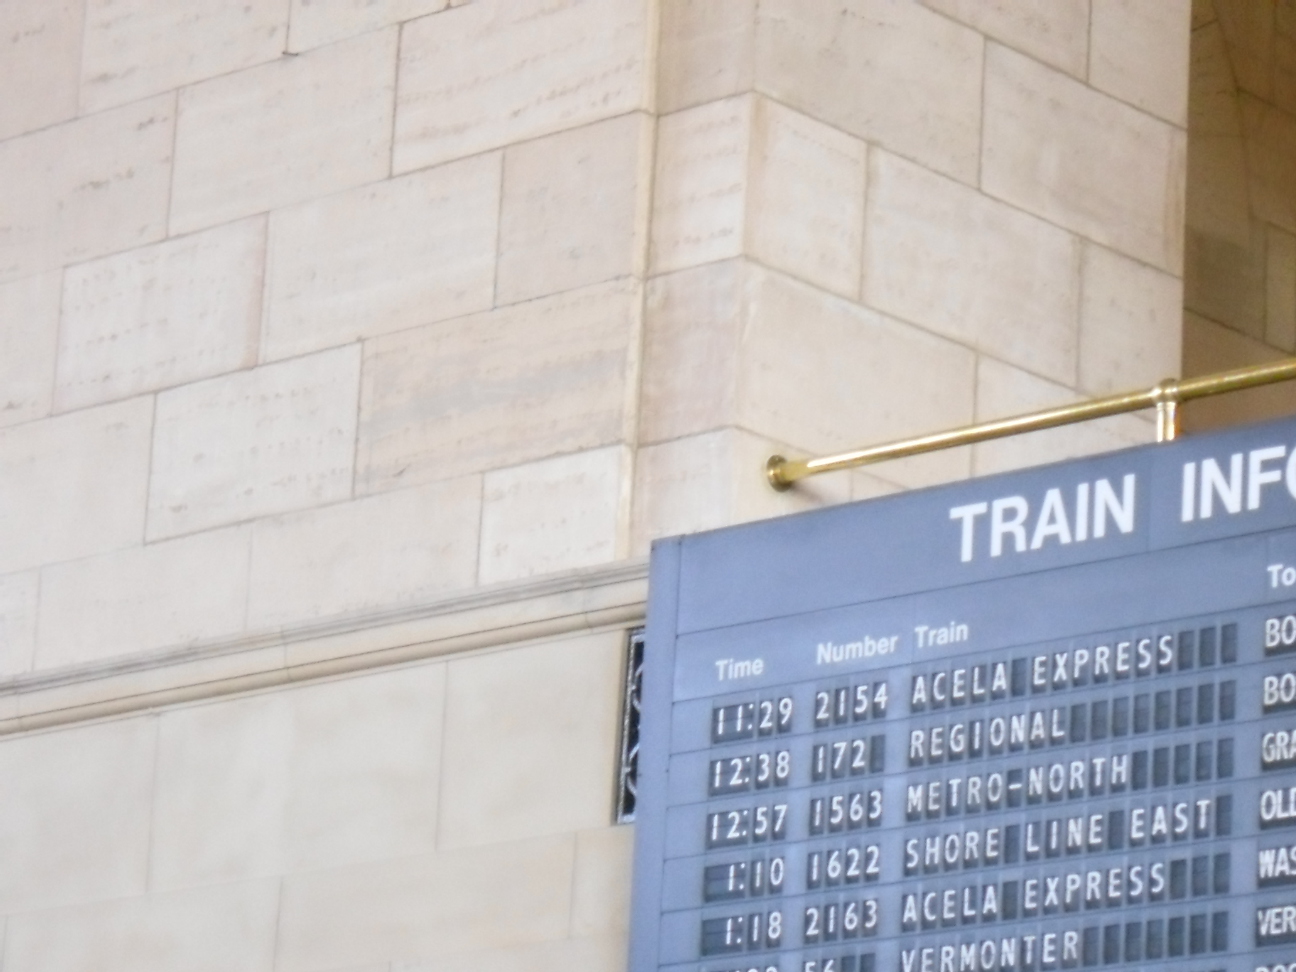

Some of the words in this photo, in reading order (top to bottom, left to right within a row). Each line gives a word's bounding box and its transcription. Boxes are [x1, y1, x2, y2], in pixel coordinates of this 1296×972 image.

[949, 473, 1136, 564] TRAIN
[714, 697, 793, 735] 11:29
[816, 682, 889, 720] 2154
[912, 662, 1008, 704] ACELA
[1032, 635, 1174, 686] EXPRESS
[716, 656, 764, 681] Time
[817, 633, 898, 664] Number
[915, 621, 968, 648] Train
[714, 751, 791, 788] 12:38
[817, 740, 866, 774] 172
[910, 707, 1065, 759] REGIONAL
[711, 804, 788, 840] 12:57
[813, 790, 883, 826] 1563
[907, 754, 1129, 814] METRO-NORTH
[727, 857, 784, 892] 1:10
[811, 845, 880, 881] 1622
[906, 827, 1000, 869] SHORE
[1025, 815, 1103, 854] LINE
[1130, 801, 1211, 840] EAST
[725, 909, 783, 945] 1:18
[806, 900, 878, 936] 2163
[903, 885, 997, 924] ACELA
[1024, 862, 1164, 910] EXPRESS
